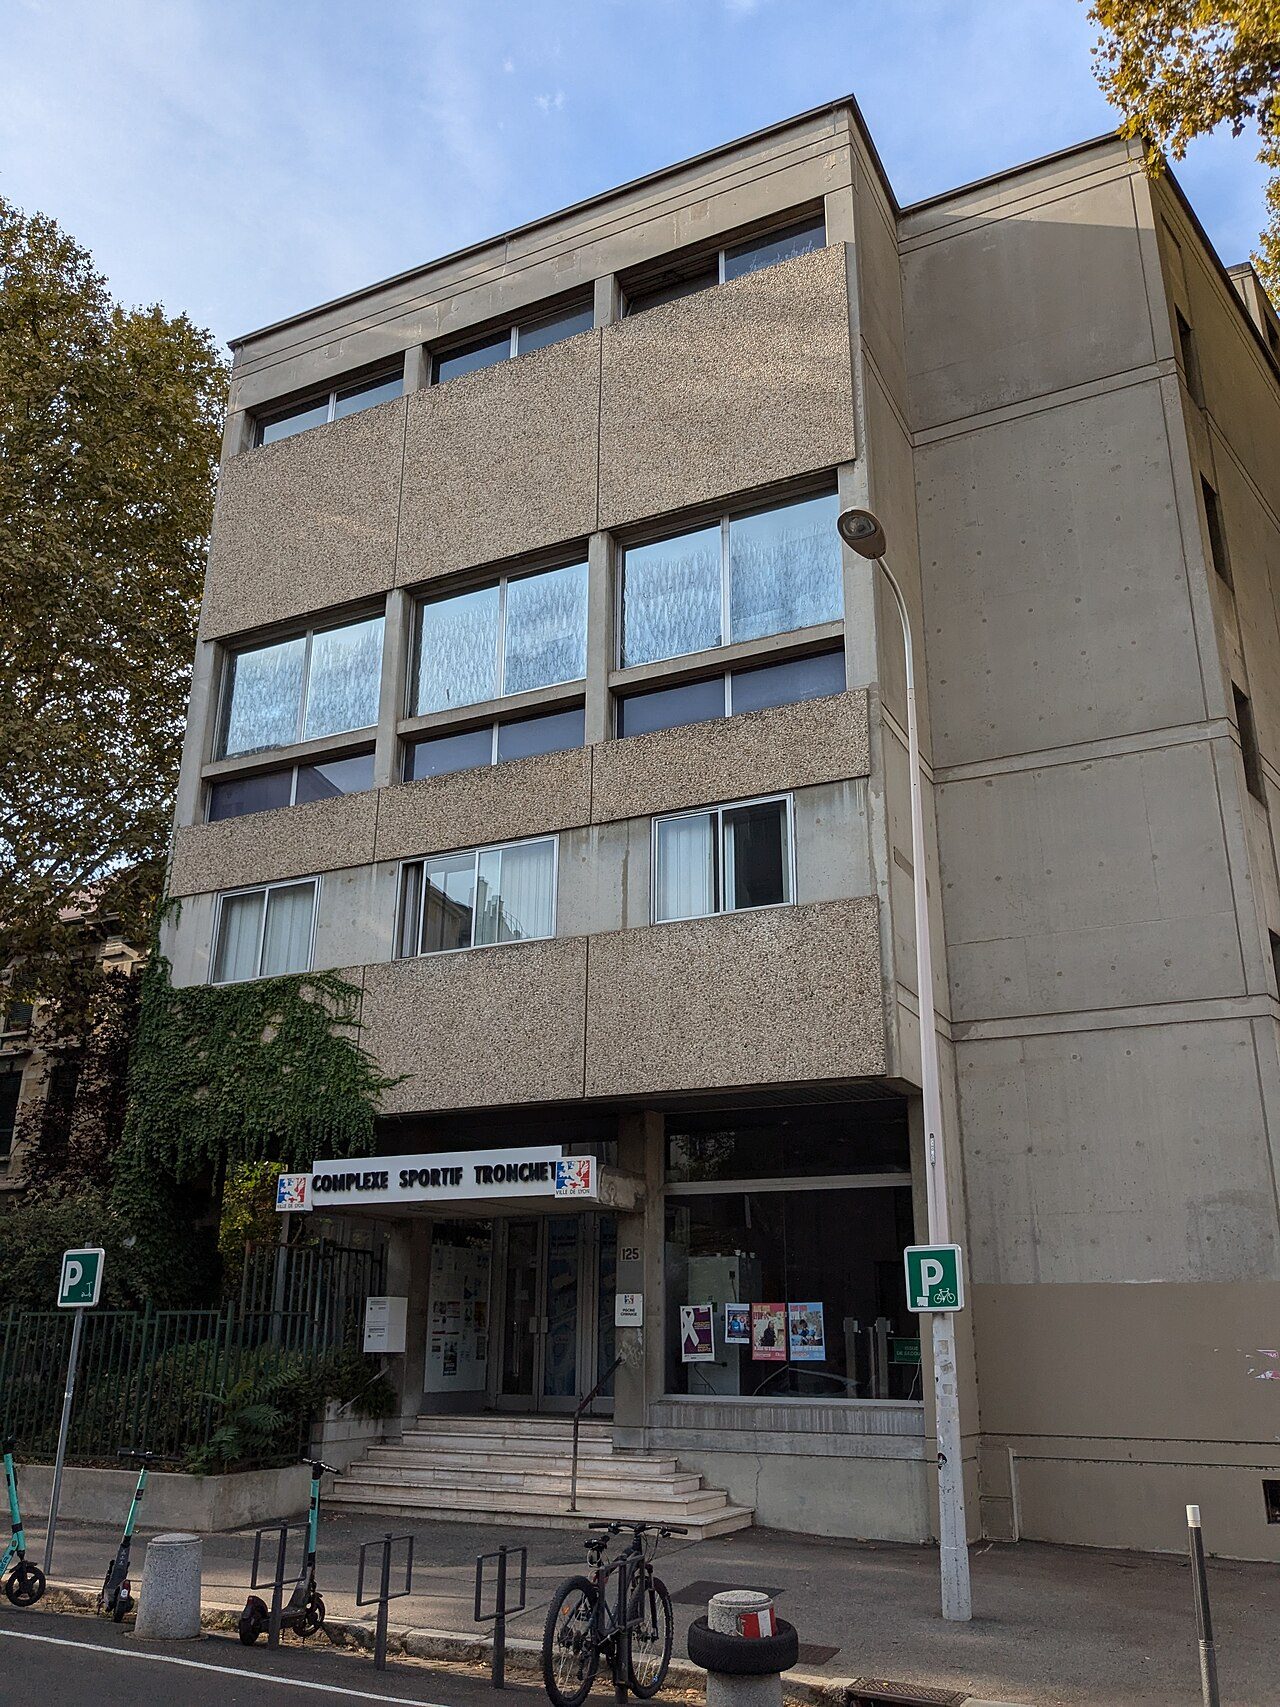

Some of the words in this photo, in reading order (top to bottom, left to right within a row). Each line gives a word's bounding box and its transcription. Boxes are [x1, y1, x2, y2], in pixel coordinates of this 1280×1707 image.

[312, 1171, 388, 1192] COMPLEXE
[399, 1167, 463, 1188] SPORTIF
[474, 1161, 556, 1184] TRONCHET
[622, 1247, 639, 1261] 125
[62, 1260, 83, 1297] P
[920, 1258, 944, 1297] P
